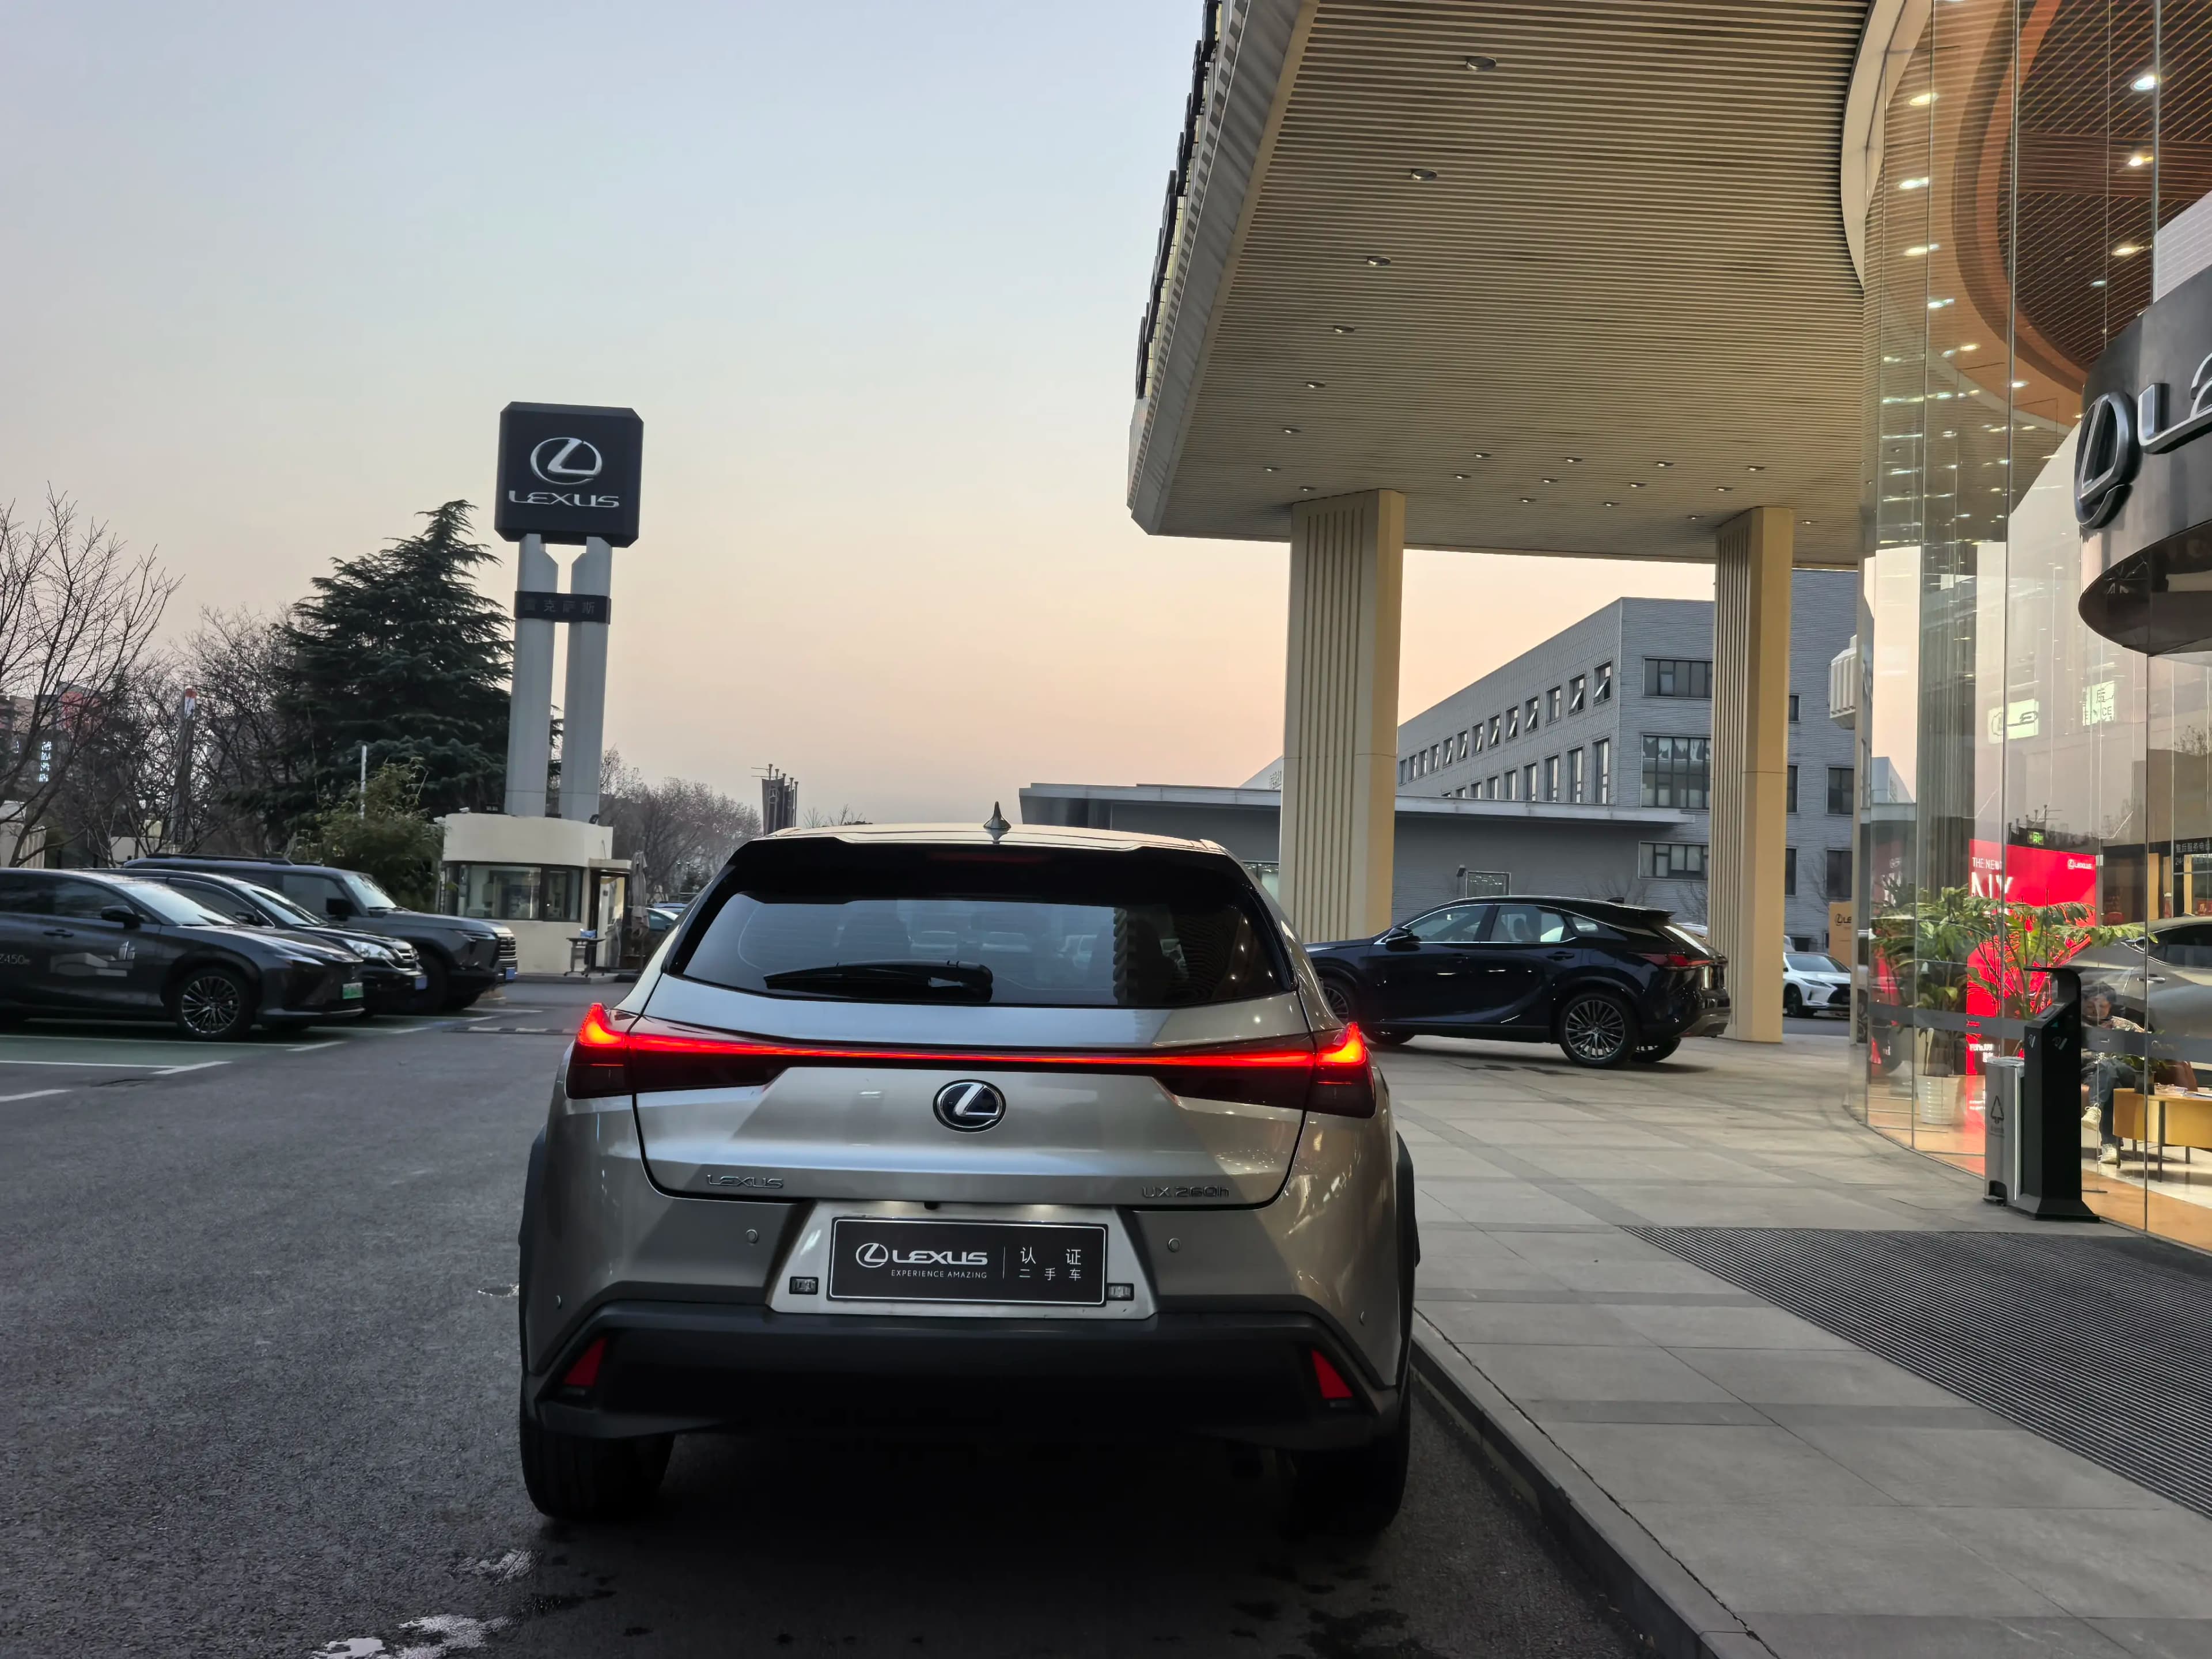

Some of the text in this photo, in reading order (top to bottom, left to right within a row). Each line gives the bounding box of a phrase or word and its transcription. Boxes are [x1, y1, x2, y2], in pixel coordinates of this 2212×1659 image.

[509, 490, 619, 508] LEXUS
[1972, 857, 1984, 868] THE
[707, 1175, 783, 1189] LEXUS
[1142, 1185, 1171, 1198] UX
[892, 1249, 988, 1266] LEXUS
[891, 1269, 987, 1279] EXPERIENCE AMAZING
